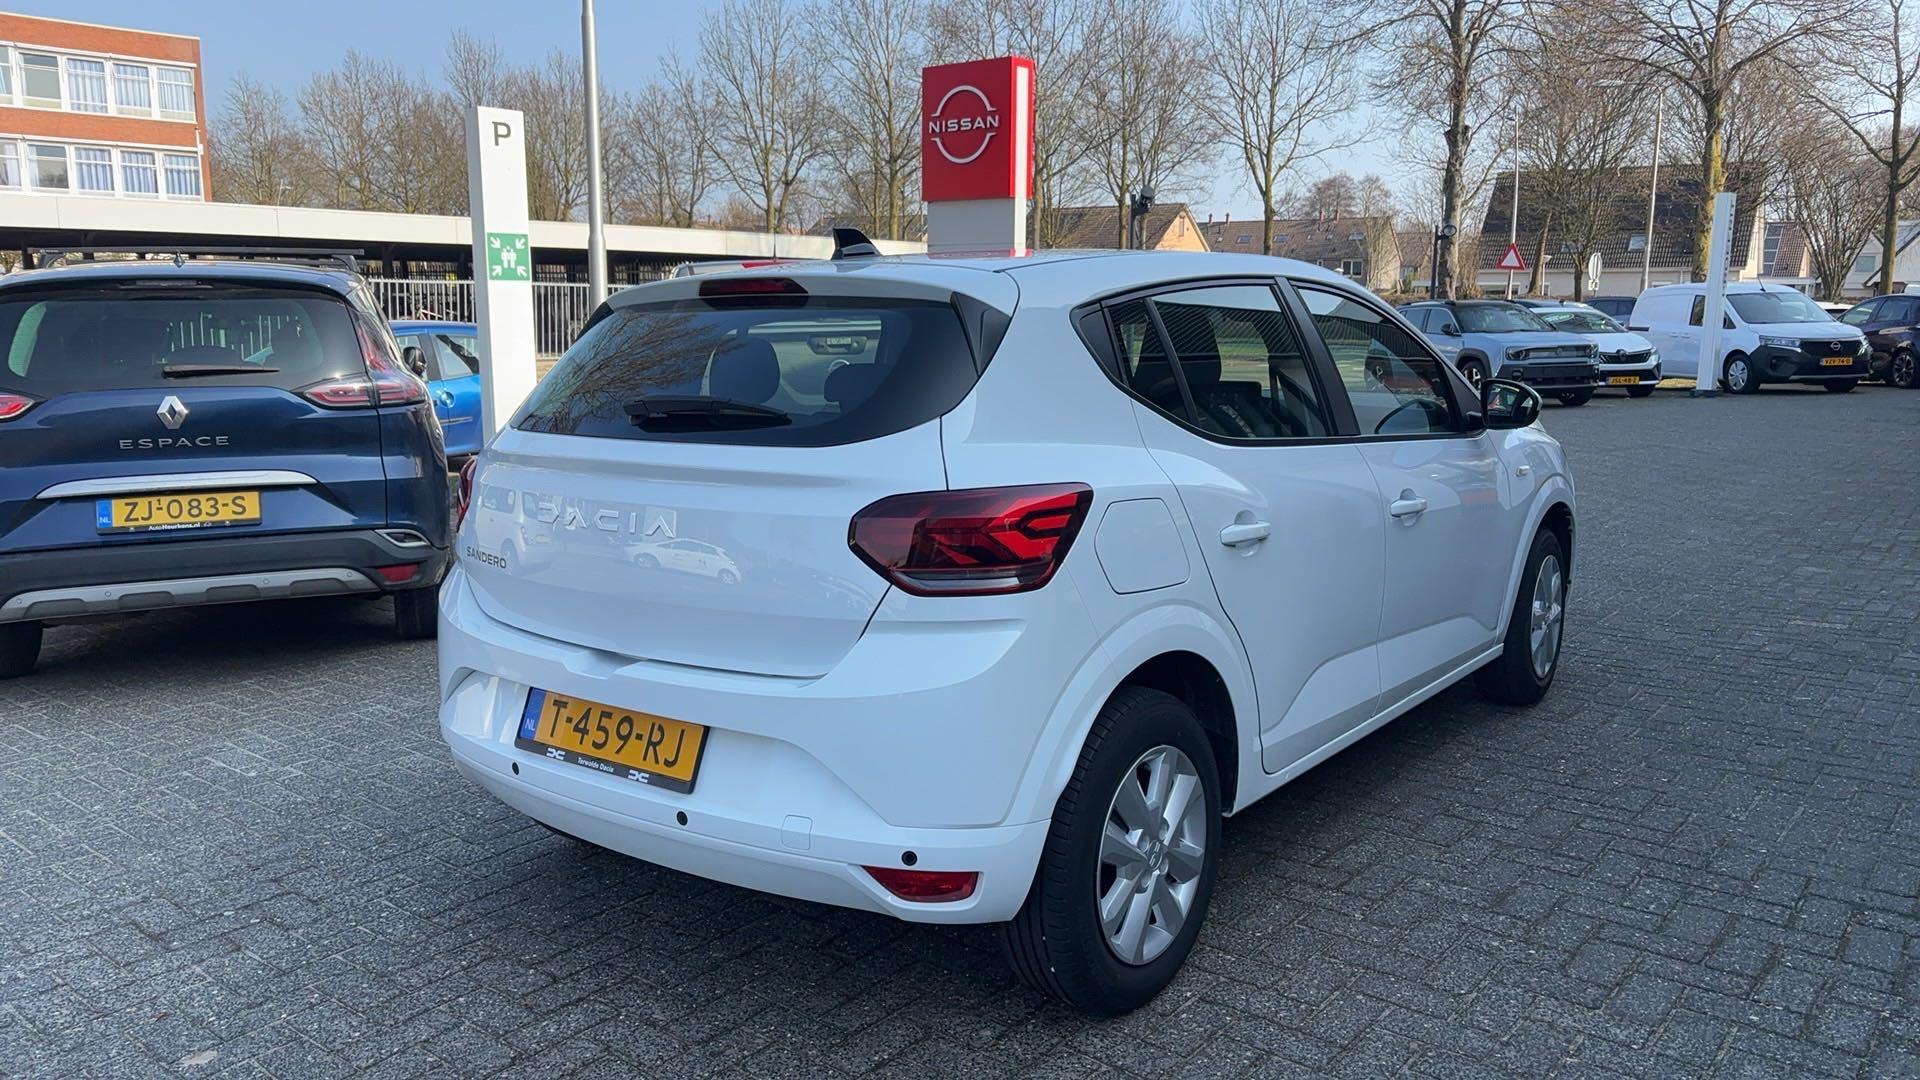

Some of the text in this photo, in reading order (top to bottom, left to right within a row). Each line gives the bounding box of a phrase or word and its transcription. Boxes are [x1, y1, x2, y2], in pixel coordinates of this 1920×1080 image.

[491, 121, 511, 146] P
[928, 115, 999, 134] NISSAN
[119, 436, 229, 449] ESPACE
[537, 502, 676, 538] DACIA
[466, 546, 507, 569] SANDERO
[524, 699, 686, 768] NL T-459-RJ
[577, 756, 615, 773] Terwolde Dacia
